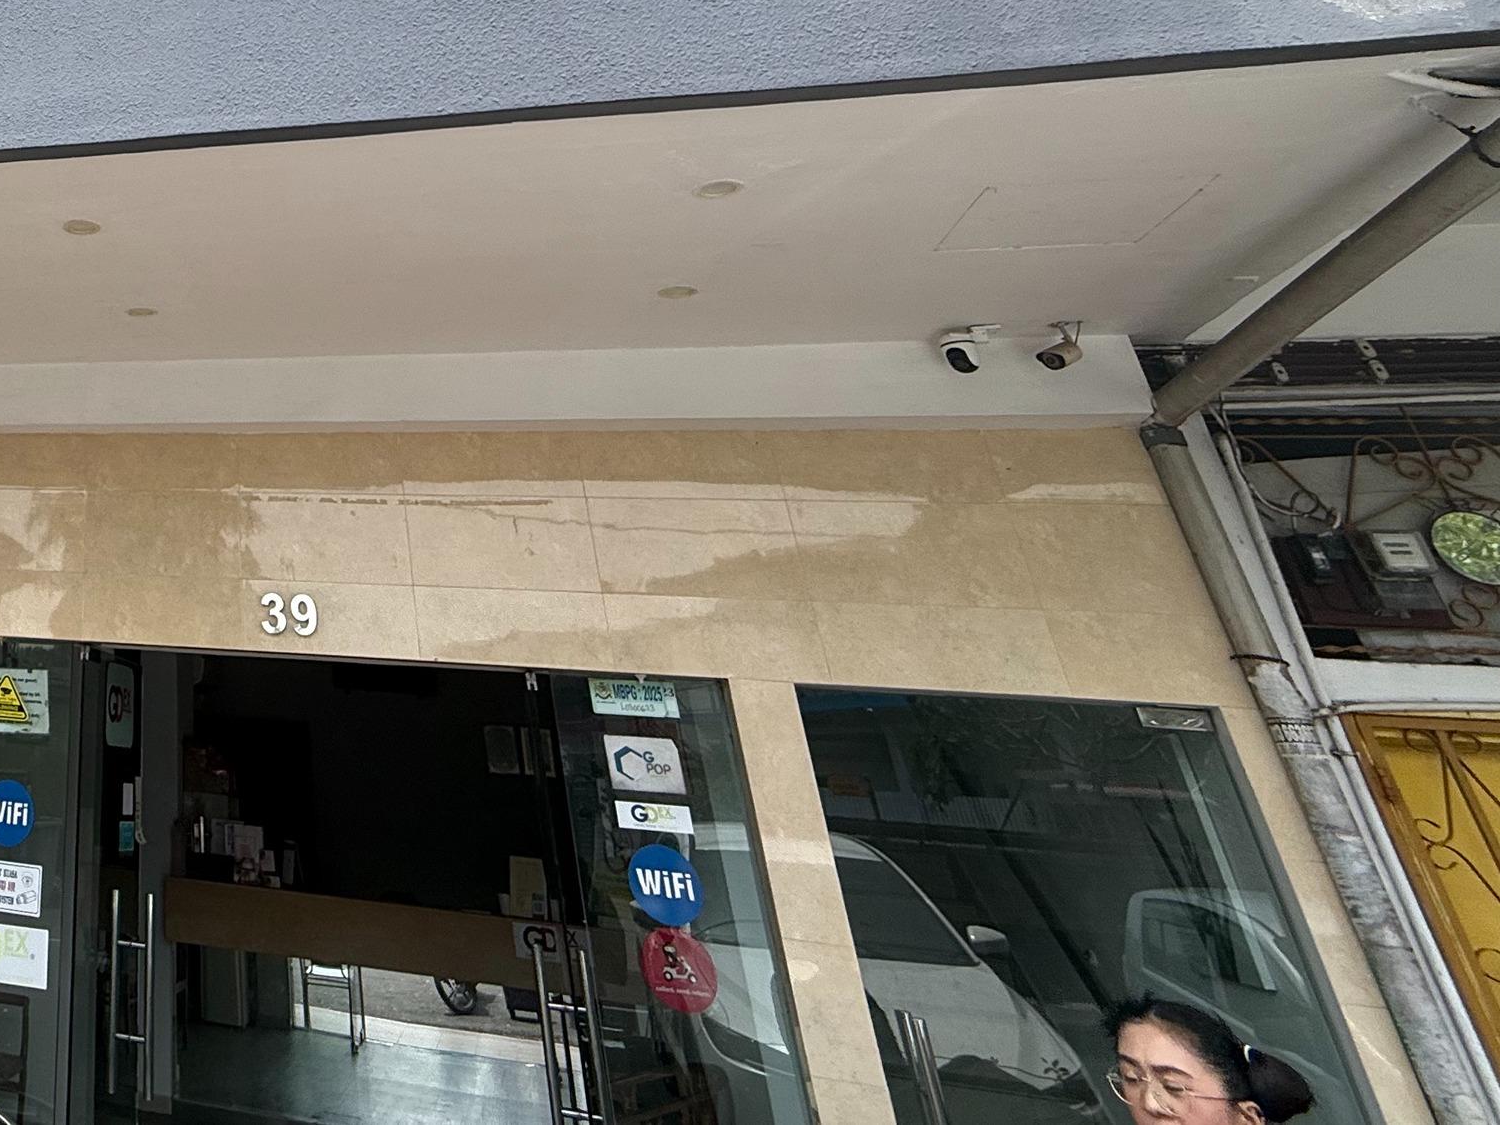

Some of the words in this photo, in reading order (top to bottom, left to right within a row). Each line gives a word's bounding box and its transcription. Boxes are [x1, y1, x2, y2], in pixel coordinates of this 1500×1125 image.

[261, 592, 318, 636] 39
[643, 751, 654, 763] G
[646, 763, 671, 775] POP
[635, 868, 695, 902] WiFi
